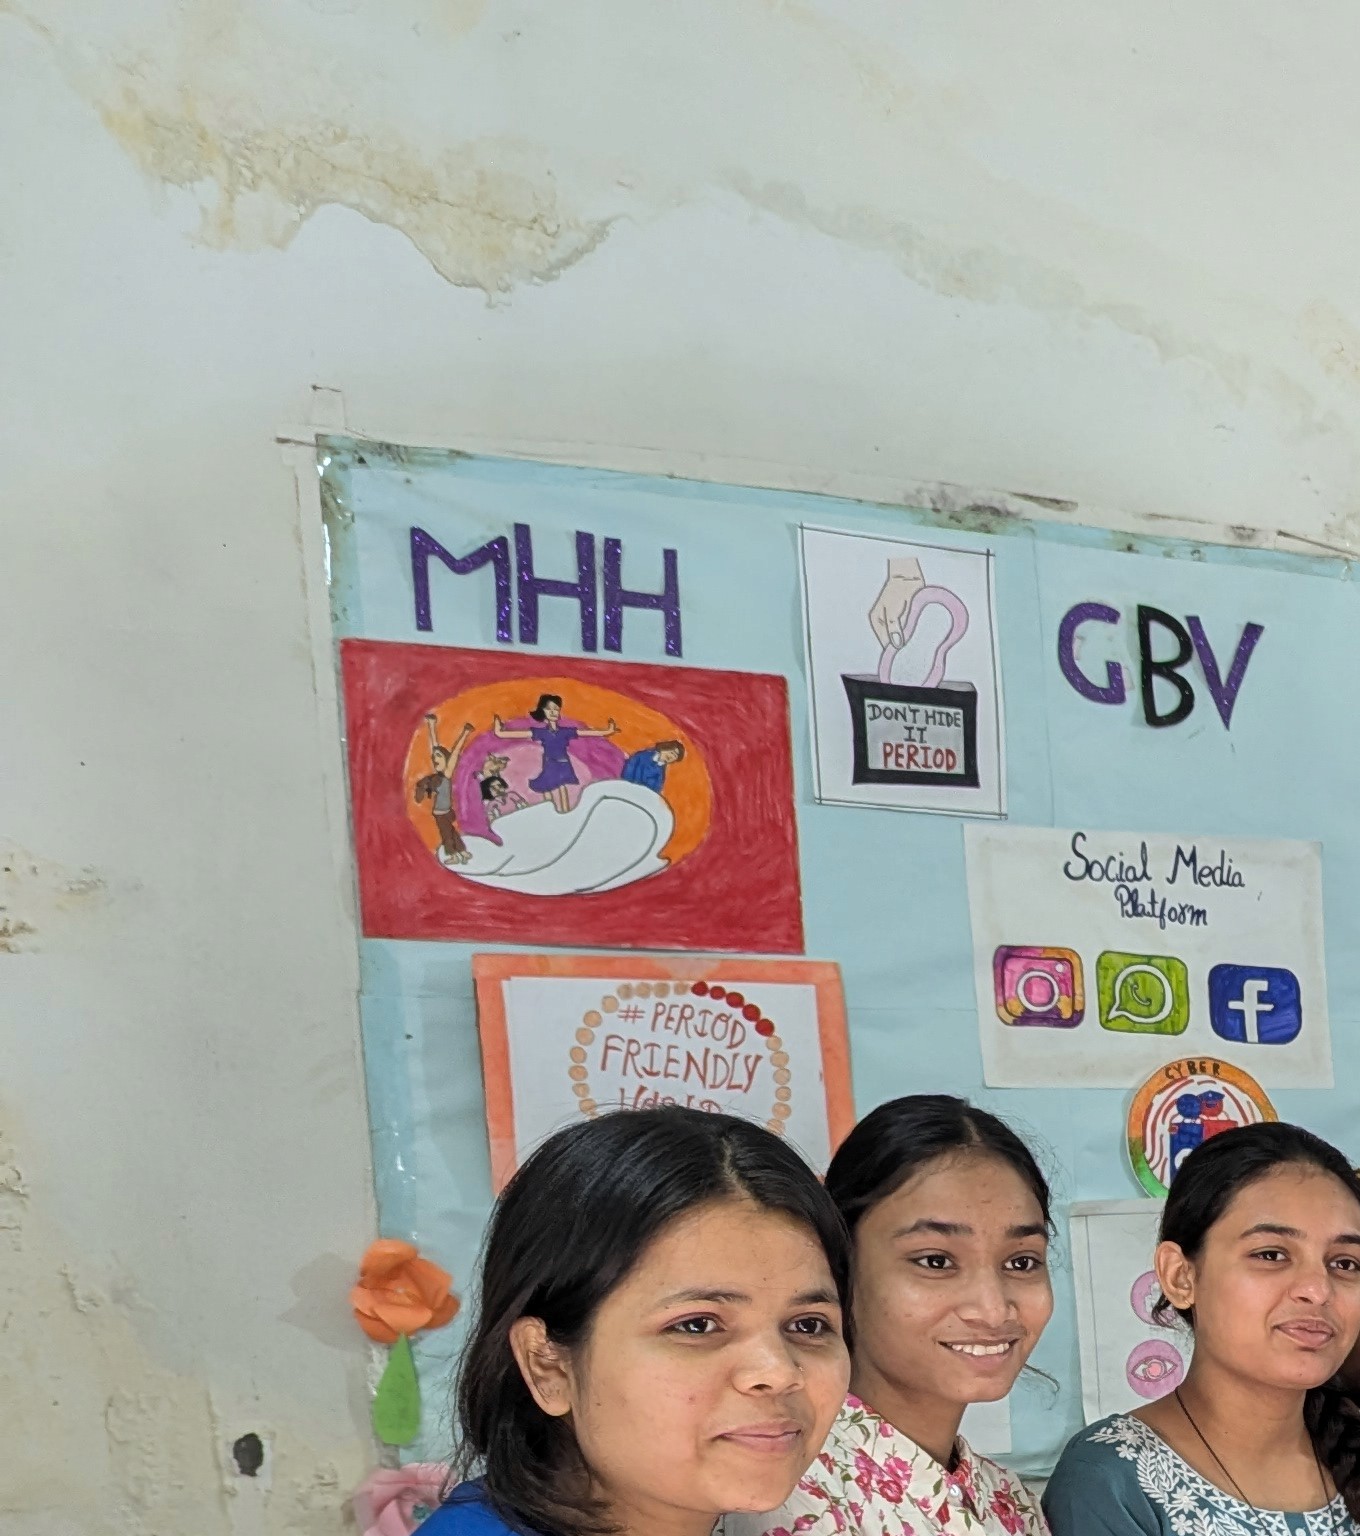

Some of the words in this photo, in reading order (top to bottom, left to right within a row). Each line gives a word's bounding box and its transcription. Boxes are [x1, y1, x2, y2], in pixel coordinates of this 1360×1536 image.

[410, 523, 682, 658] MHH
[1058, 602, 1265, 731] GBV
[868, 703, 921, 724] DON'T
[923, 706, 962, 728] HIDE
[903, 726, 928, 743] IT
[881, 741, 957, 772] PERIOD
[1063, 832, 1152, 884] Social
[1166, 843, 1246, 889] Media
[1114, 884, 1209, 927] Platform
[651, 1002, 747, 1050] PERIOD
[600, 1034, 764, 1094] FRIENDLY
[1165, 1060, 1221, 1080] CYBER
